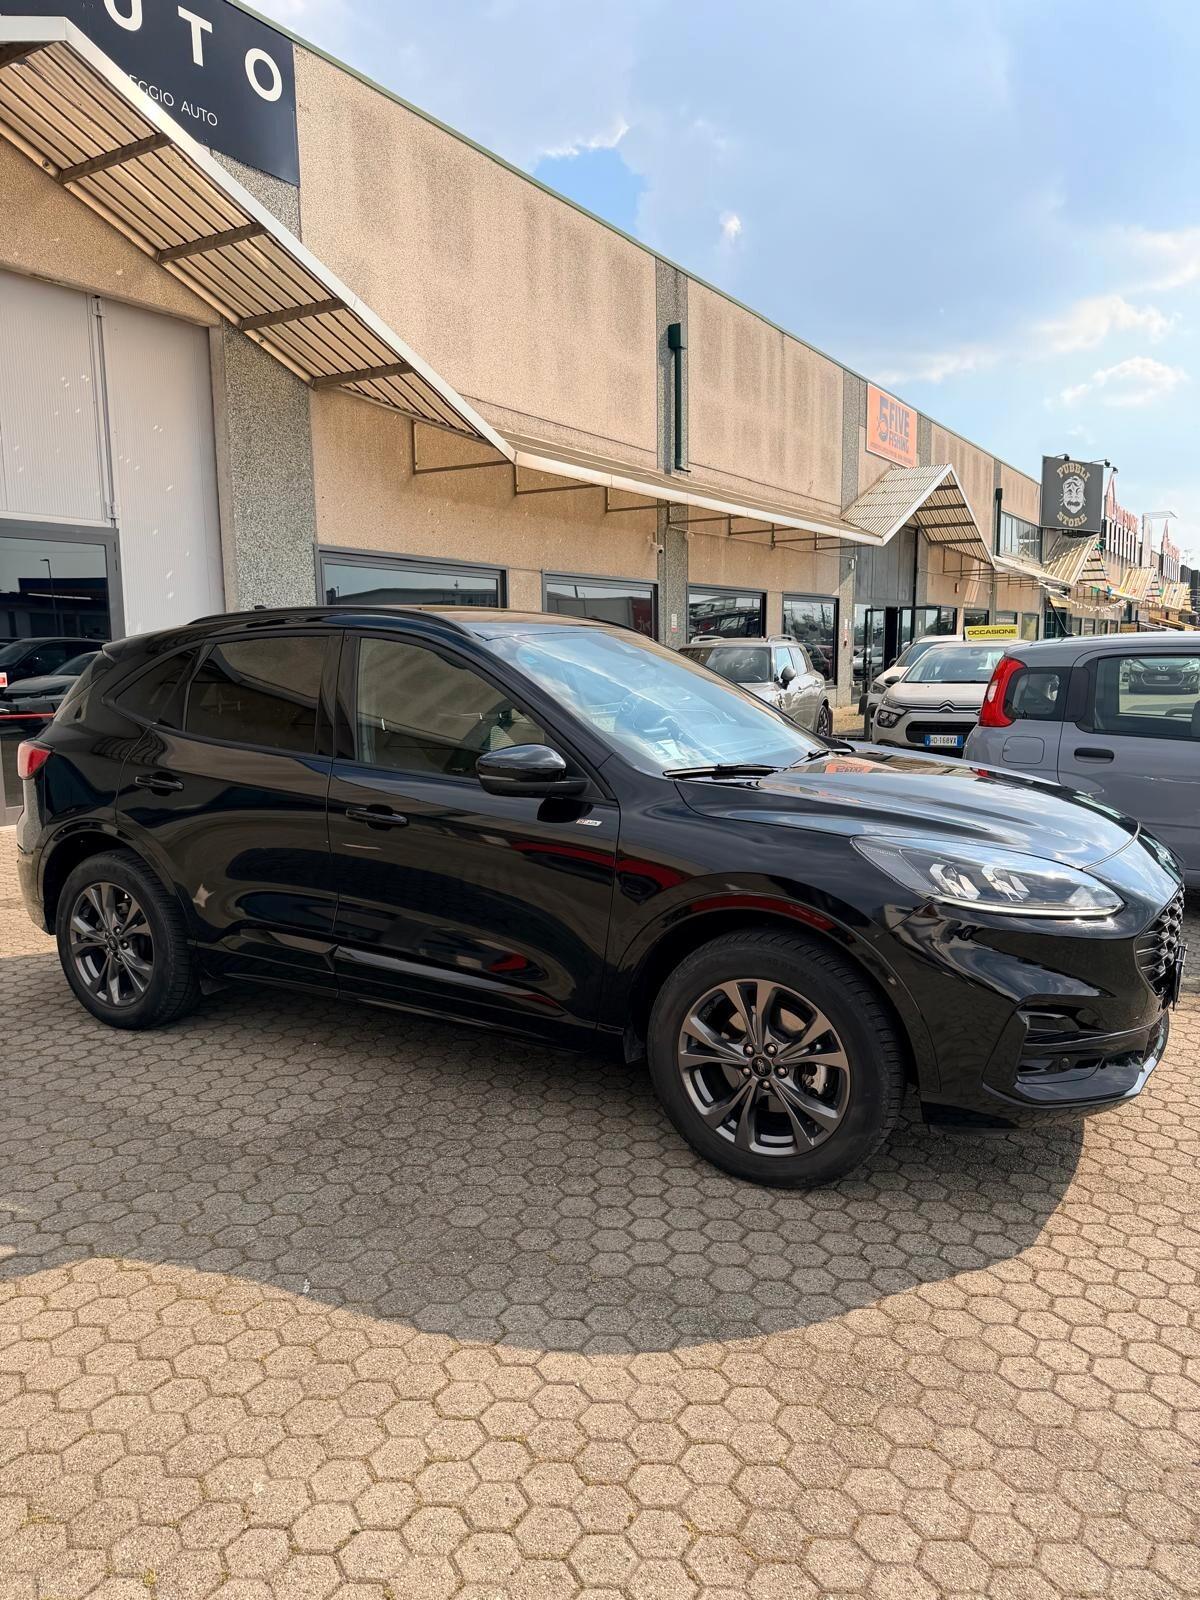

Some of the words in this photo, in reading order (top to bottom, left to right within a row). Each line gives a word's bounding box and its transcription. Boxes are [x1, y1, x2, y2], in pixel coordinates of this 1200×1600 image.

[181, 100, 218, 126] AUTO
[1056, 511, 1088, 527] STORE
[967, 628, 1017, 636] OCCASIONE
